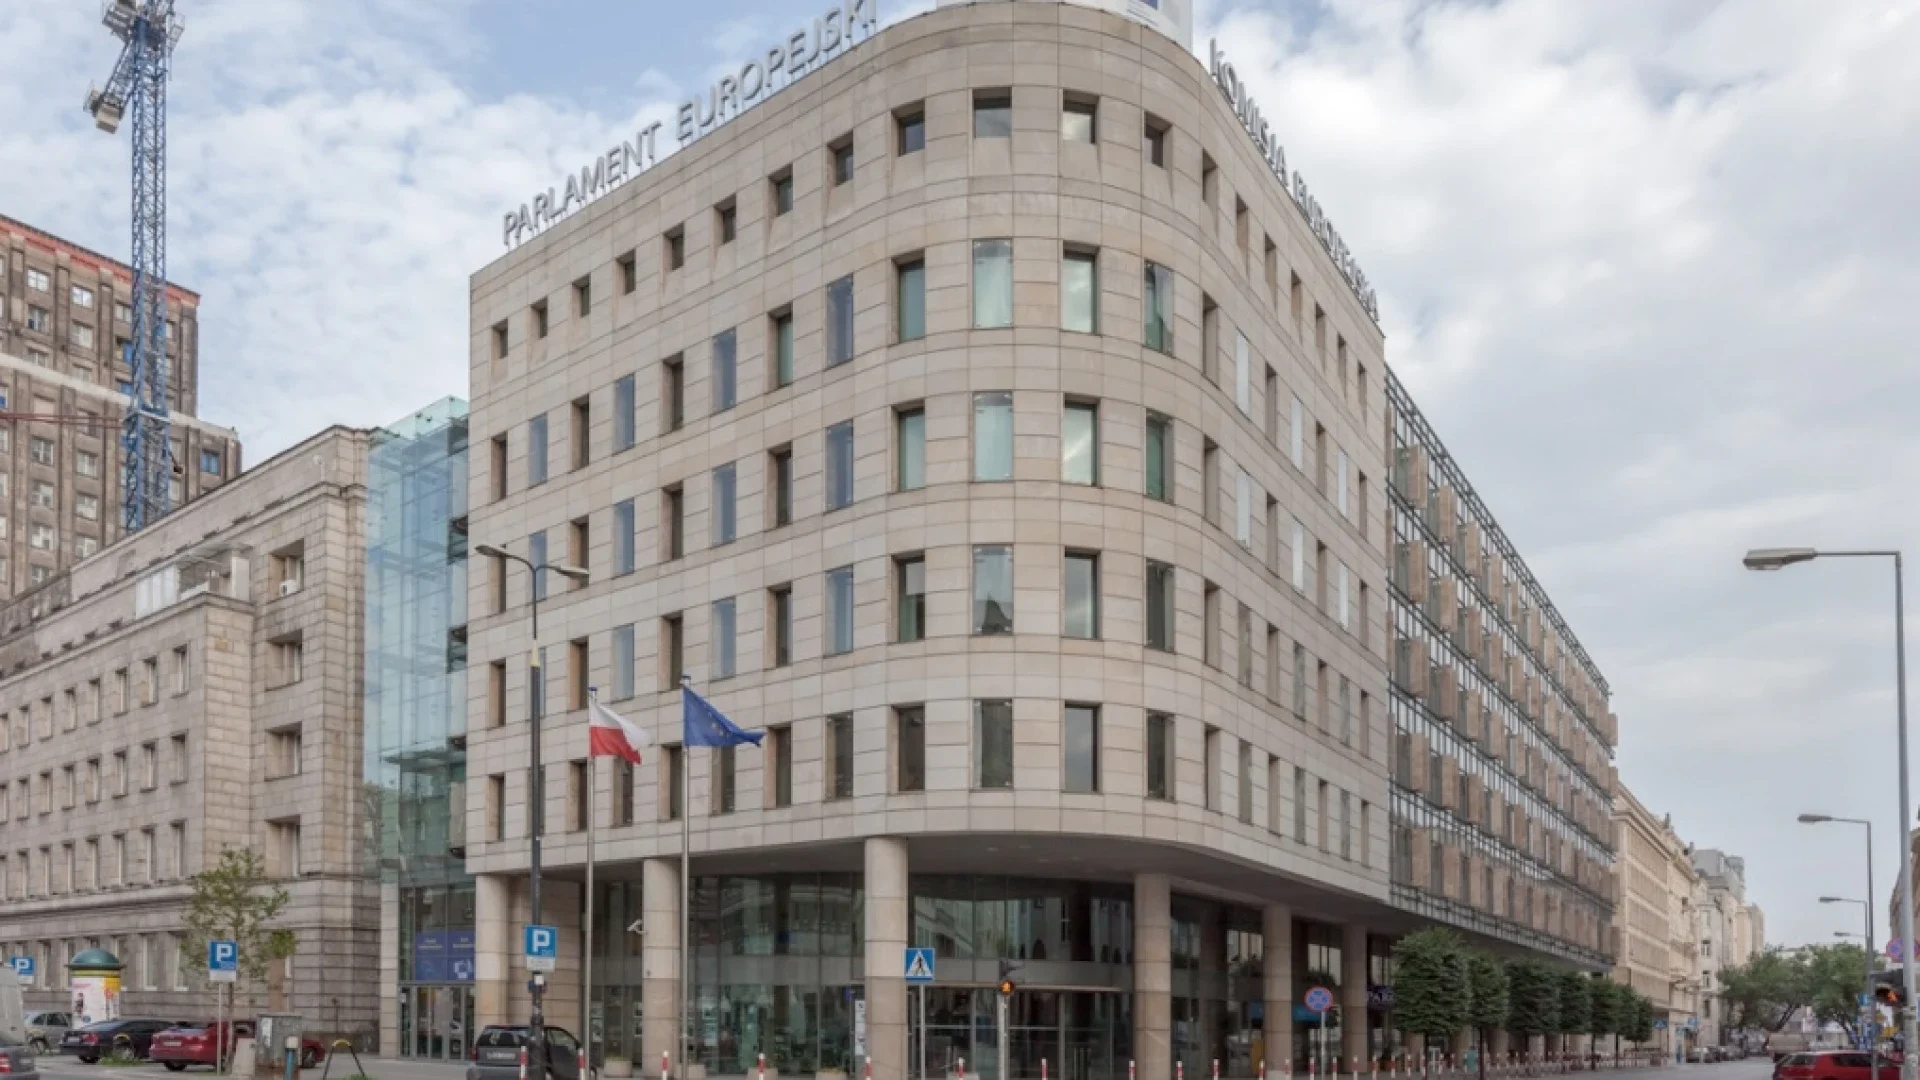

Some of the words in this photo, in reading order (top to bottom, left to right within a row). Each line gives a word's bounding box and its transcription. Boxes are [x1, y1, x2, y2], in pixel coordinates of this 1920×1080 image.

[503, 120, 662, 246] PARLAMENT
[216, 943, 233, 962] P
[532, 930, 551, 953] P
